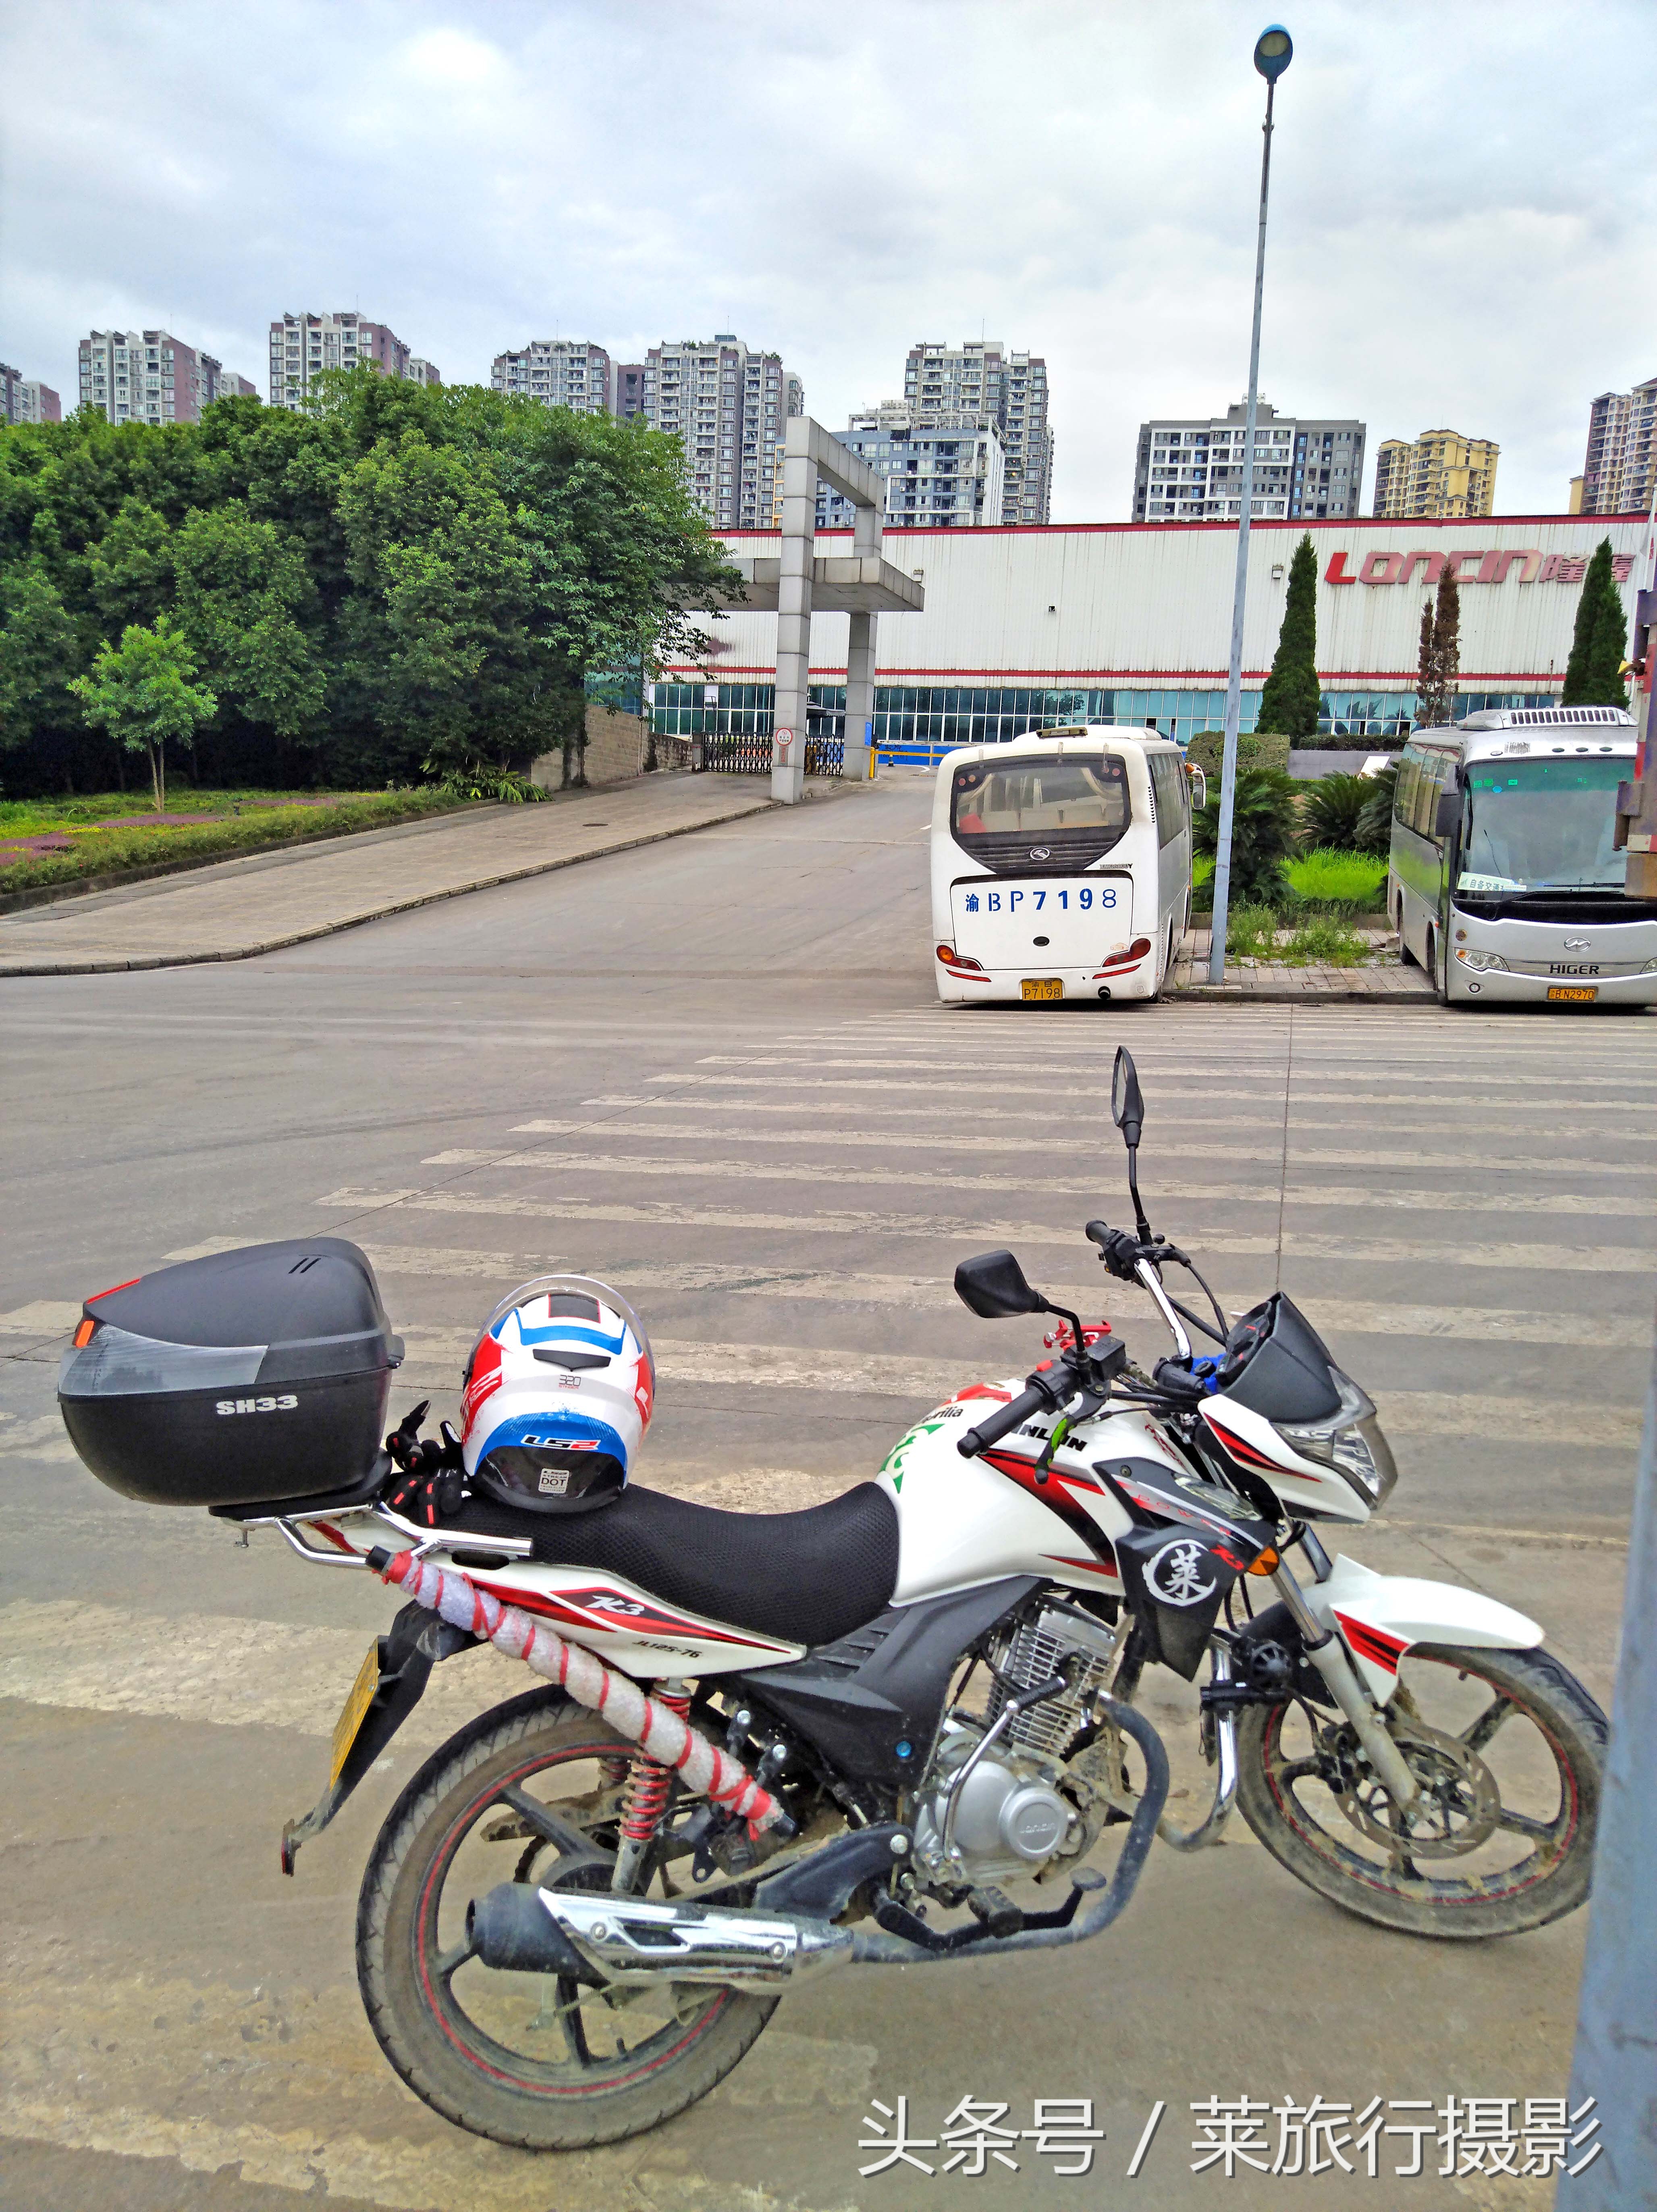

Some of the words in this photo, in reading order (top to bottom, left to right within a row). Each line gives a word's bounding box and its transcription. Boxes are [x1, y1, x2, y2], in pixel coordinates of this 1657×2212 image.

[966, 888, 1117, 913] 渝BP7198
[1550, 965, 1599, 975] HIGER
[1024, 988, 1060, 999] P7198
[559, 1374, 581, 1387] 320
[216, 1395, 298, 1415] SH33
[521, 1434, 601, 1450] LS2
[541, 1478, 566, 1486] DOT
[585, 1595, 645, 1616] K3
